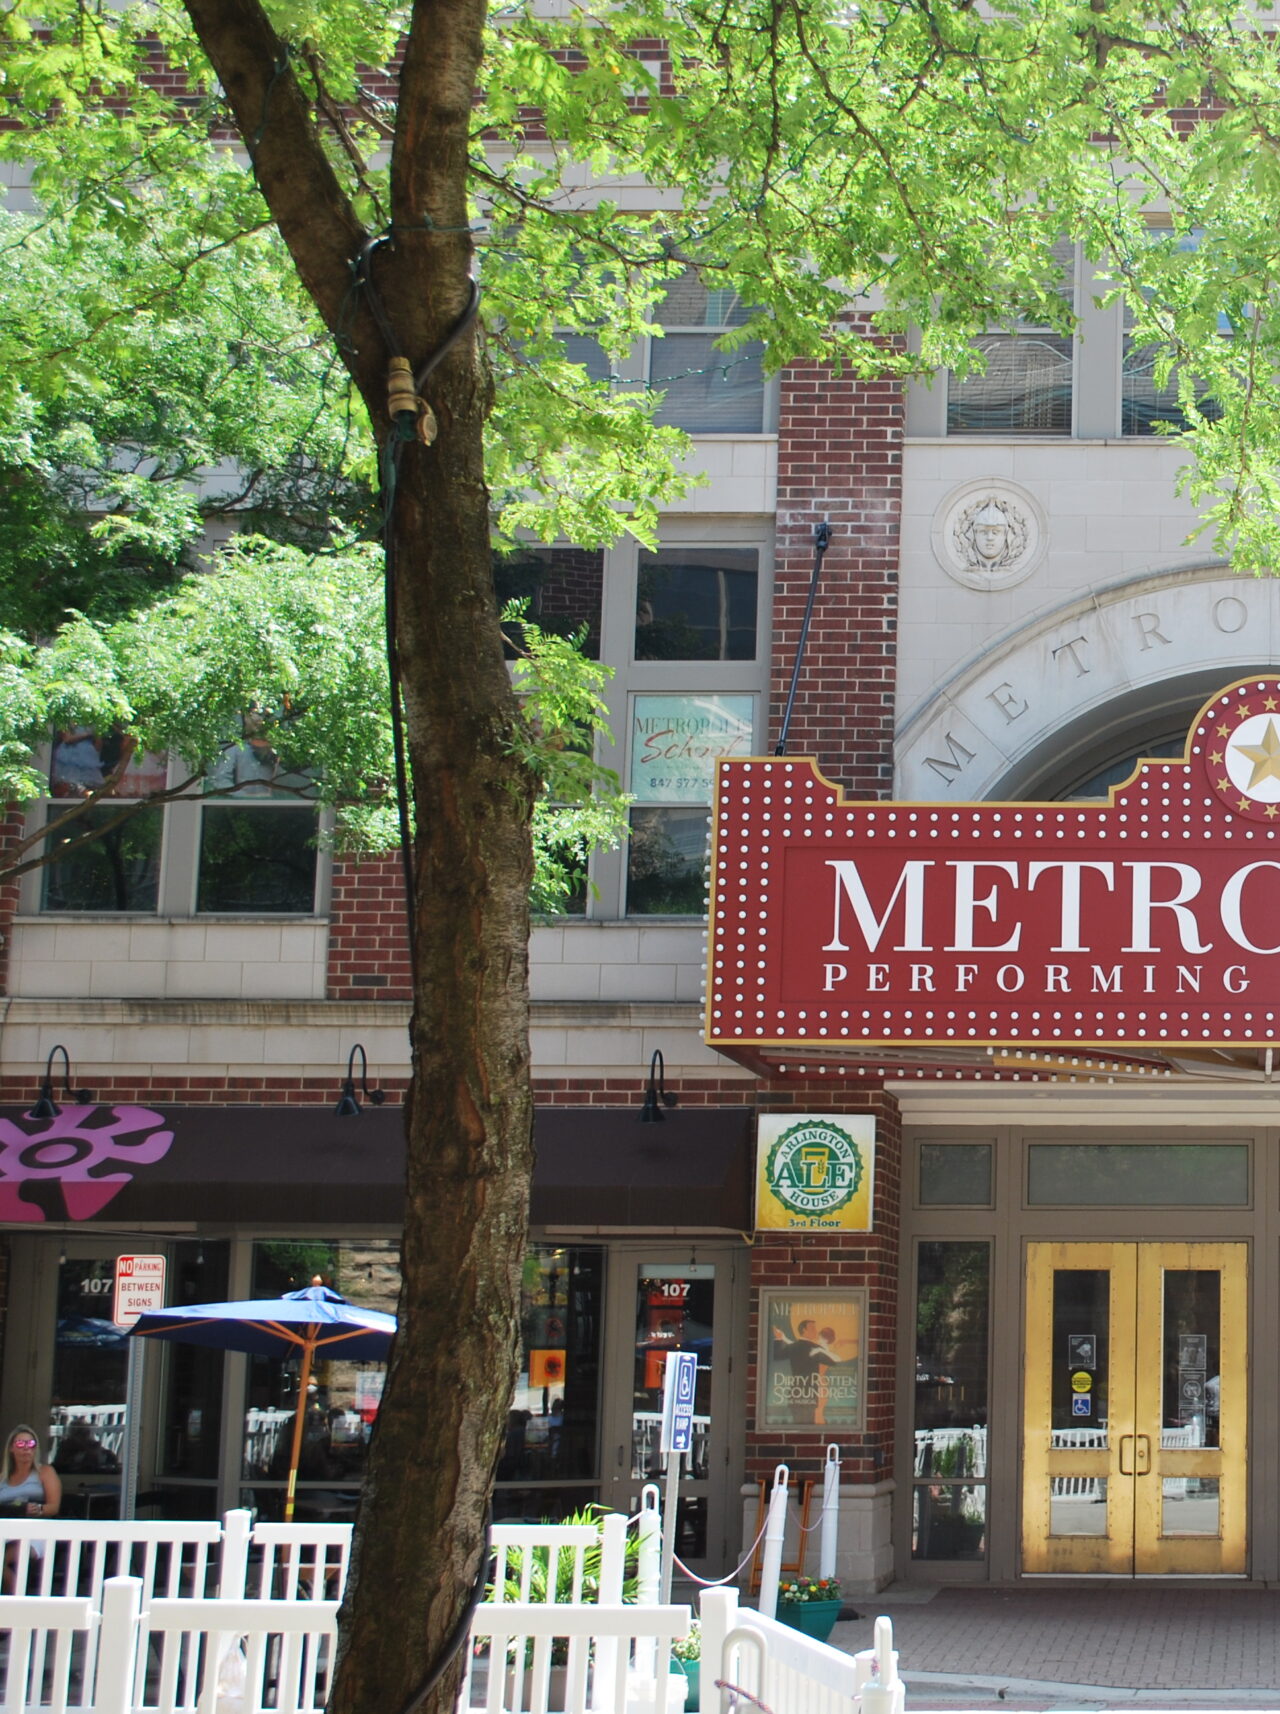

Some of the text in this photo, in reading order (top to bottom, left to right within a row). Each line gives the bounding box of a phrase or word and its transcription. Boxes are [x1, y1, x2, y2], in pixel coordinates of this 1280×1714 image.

[640, 729, 743, 763] School
[650, 778, 672, 788] 847
[677, 778, 698, 788] 577
[821, 964, 1251, 993] PERFORMING
[781, 1130, 851, 1159] ARLINGTON
[770, 1160, 854, 1189] ALE
[789, 1190, 840, 1207] HOUSE
[789, 1218, 841, 1227] 3rd Floor
[120, 1260, 161, 1274] NO PARKING
[80, 1279, 113, 1293] 107
[121, 1282, 160, 1291] BETWEEN
[661, 1283, 691, 1297] 107
[127, 1298, 152, 1307] SIGNS
[774, 1372, 858, 1386] DIRTY ROTTEN
[773, 1386, 858, 1405] SCOUNDRELS
